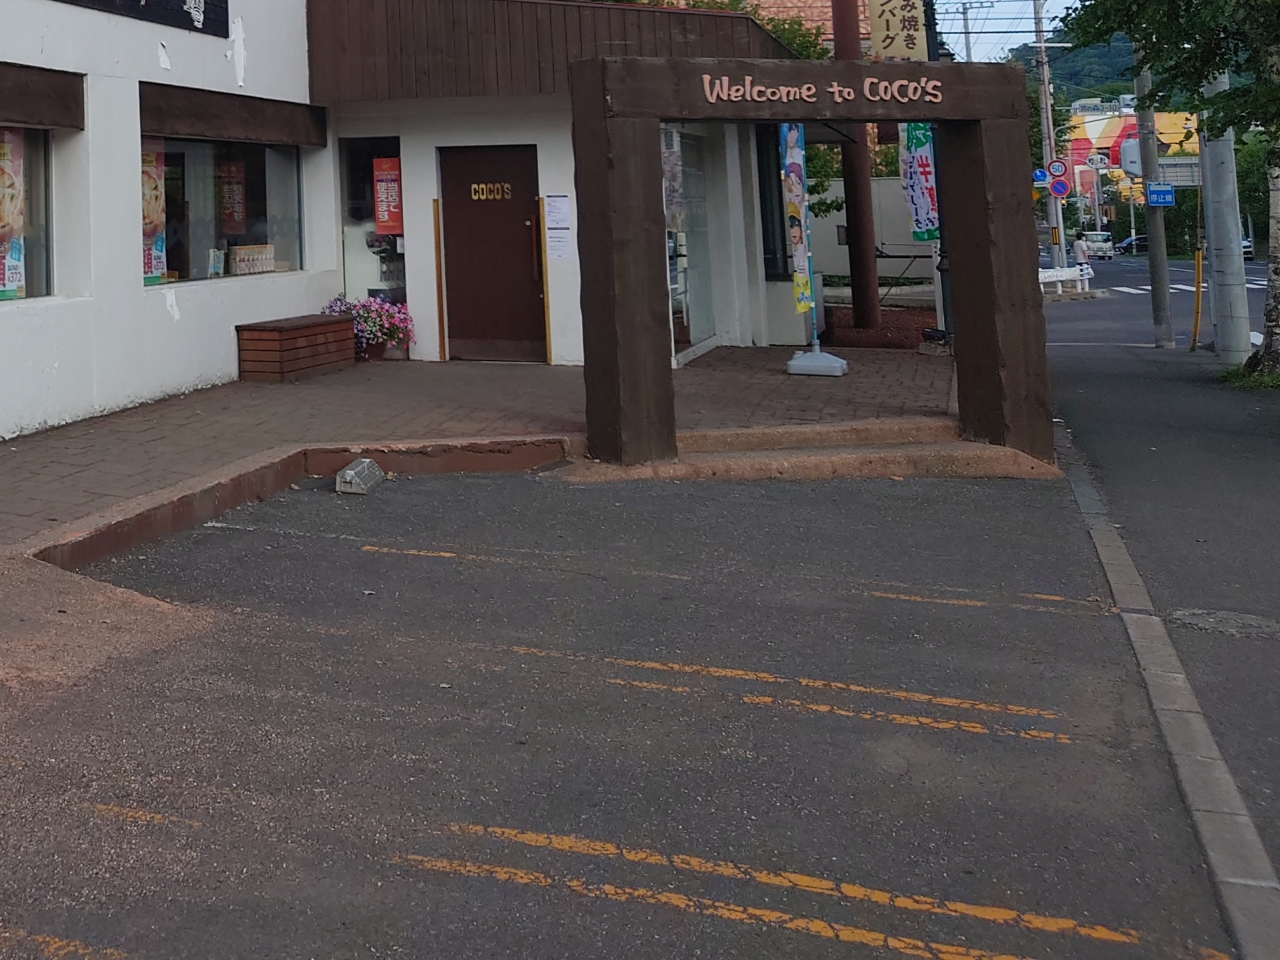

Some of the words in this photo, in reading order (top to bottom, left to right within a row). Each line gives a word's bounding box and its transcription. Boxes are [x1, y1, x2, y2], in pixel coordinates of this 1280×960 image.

[701, 73, 818, 104] Welcome
[826, 81, 855, 103] to
[1051, 164, 1064, 173] 50
[377, 182, 390, 221] 使えます
[388, 182, 400, 212] 当店で
[471, 182, 512, 200] COCO'S
